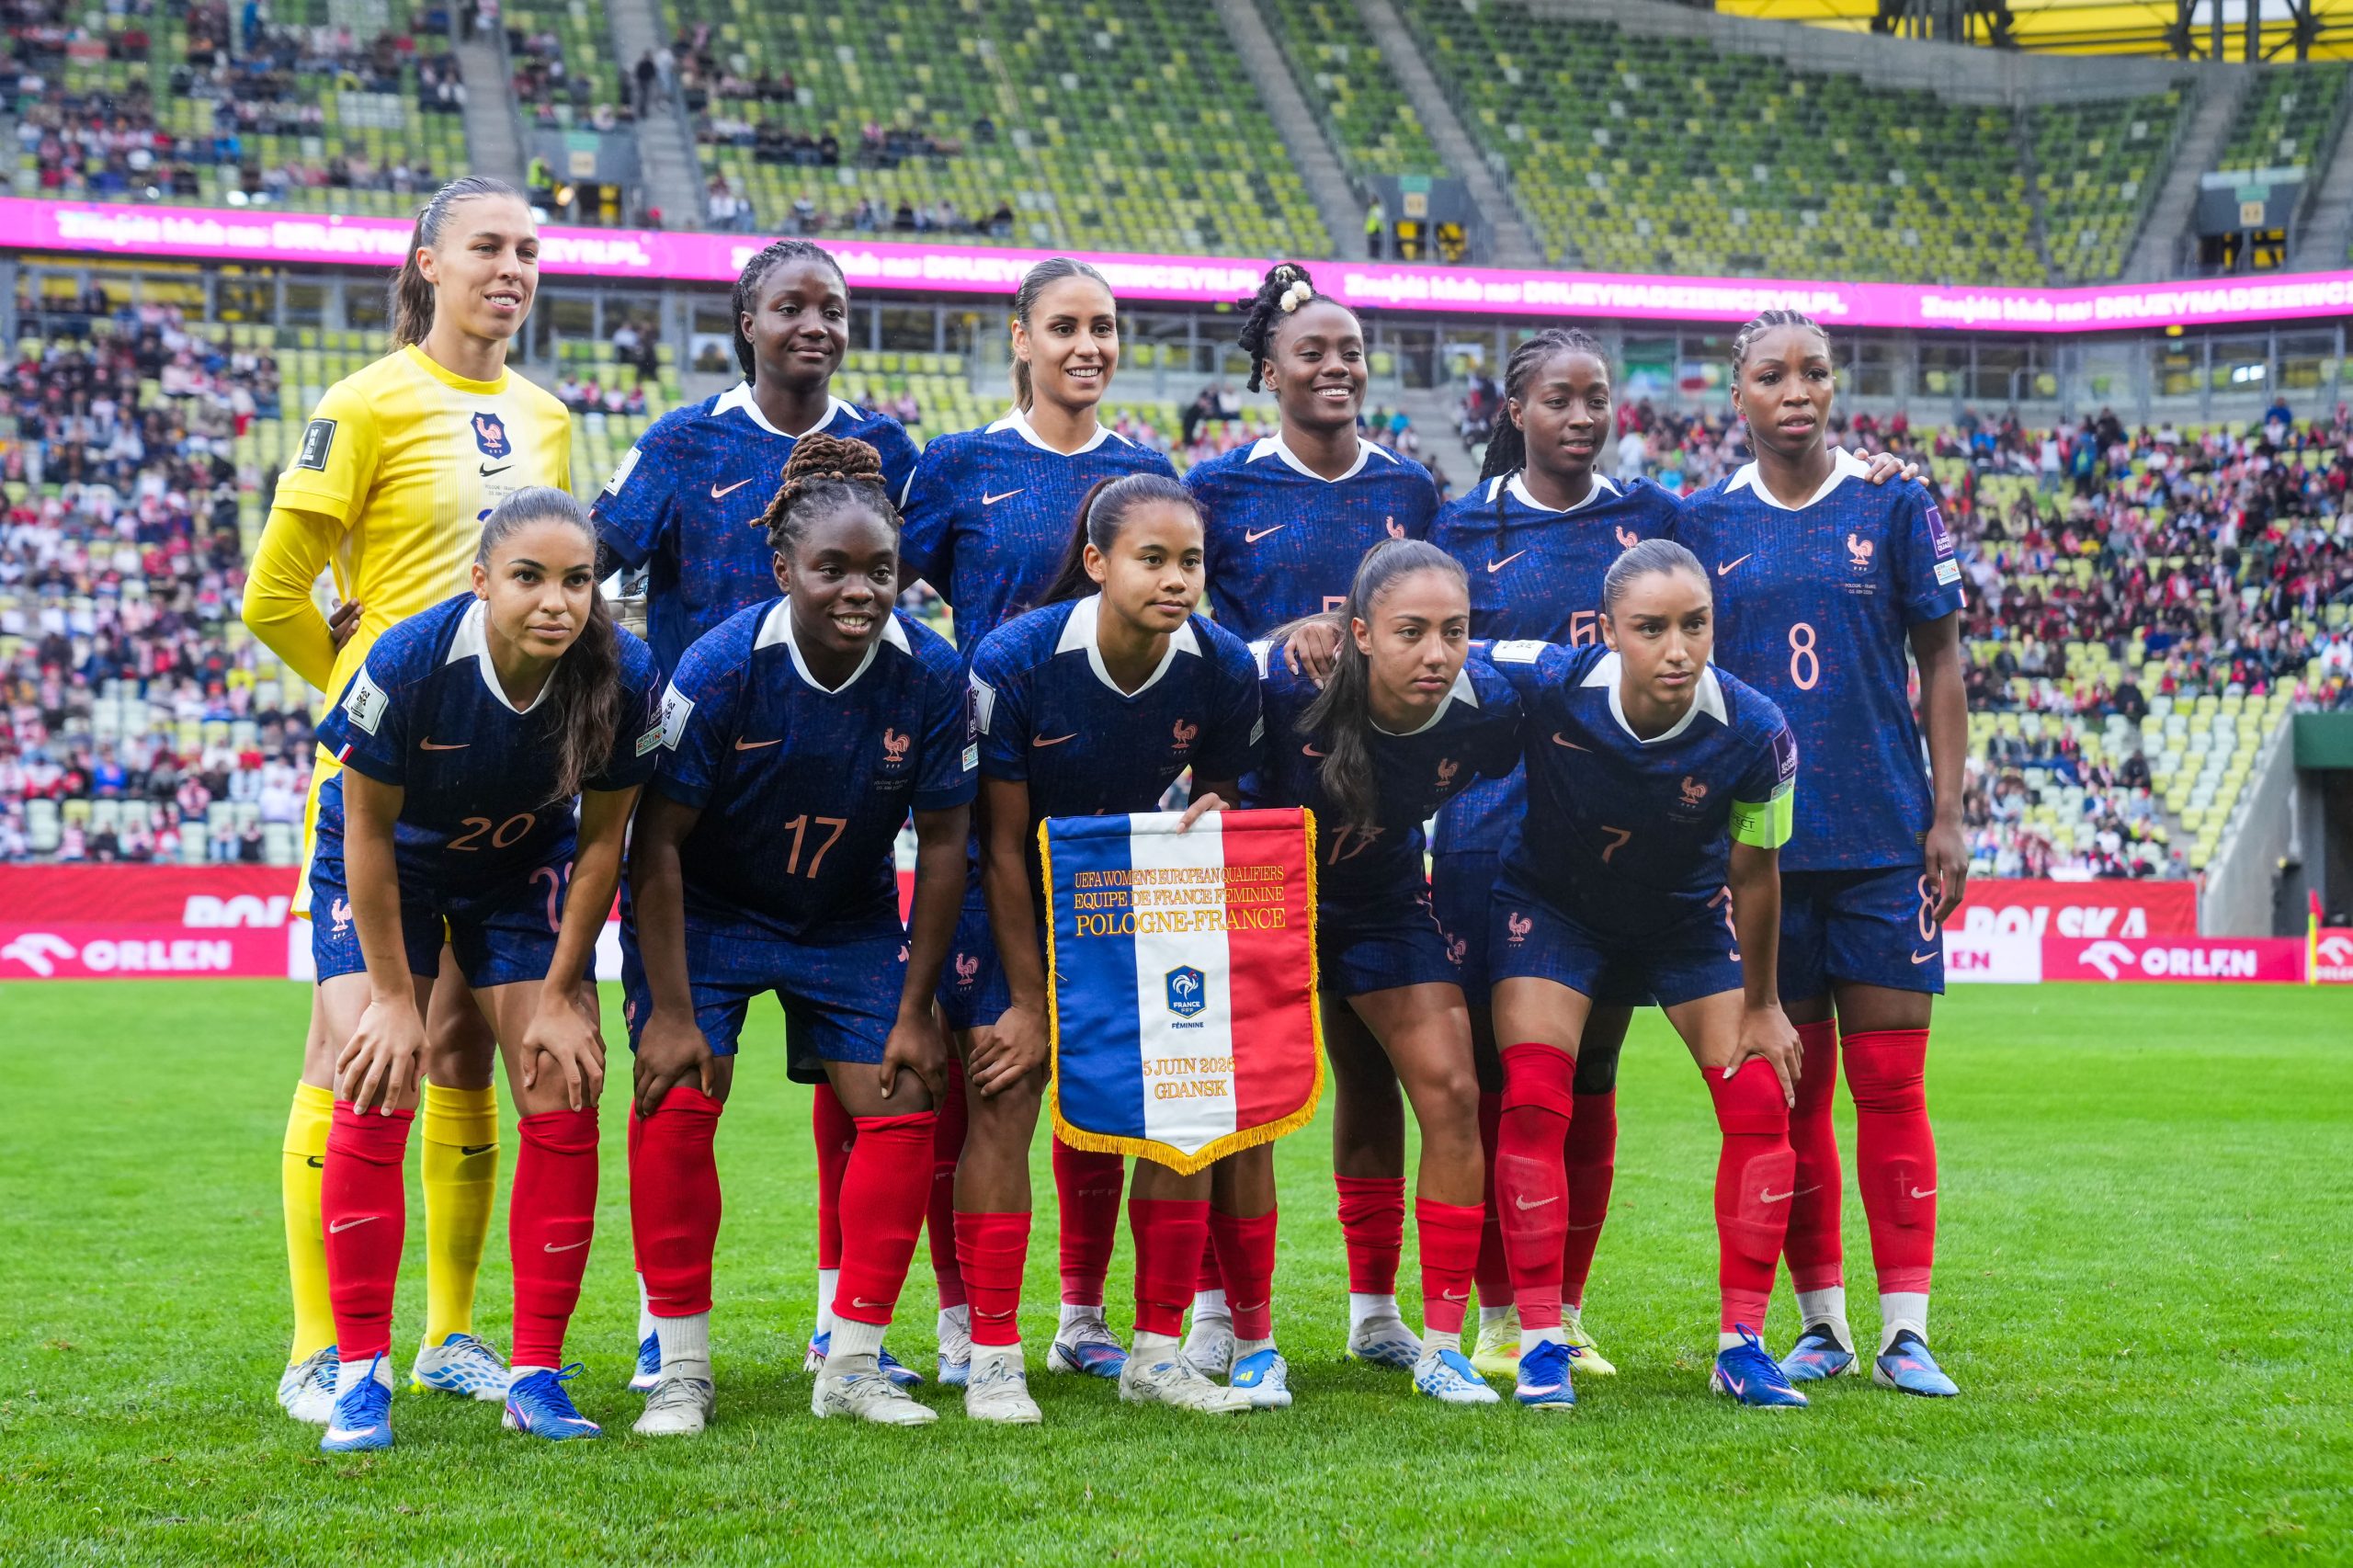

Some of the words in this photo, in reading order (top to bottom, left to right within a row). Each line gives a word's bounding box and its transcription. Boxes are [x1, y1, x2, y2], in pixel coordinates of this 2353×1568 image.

[1789, 622, 1819, 690] 8
[446, 812, 536, 851] 20
[784, 814, 847, 879] 17
[1601, 825, 1631, 863] 7
[1074, 871, 1103, 888] UEFA
[1103, 869, 1156, 887] WOMEN'S
[1158, 868, 1221, 885] EUROPEAN
[1222, 866, 1284, 883] QUALIFIERS
[1074, 892, 1127, 910] EQUIPE
[1131, 890, 1151, 906] DE
[1154, 889, 1211, 905] FRANCE
[1214, 887, 1284, 904] FEMININE
[1075, 907, 1286, 937] POLOGNE-FRANCE
[82, 939, 231, 971] ORLEN
[1950, 950, 1990, 969] EN
[2141, 947, 2257, 977] ORLEN
[1142, 1060, 1153, 1076] 5
[1154, 1057, 1197, 1076] JUIN
[1199, 1056, 1235, 1074] 2026
[1154, 1079, 1227, 1099] GDANSK
